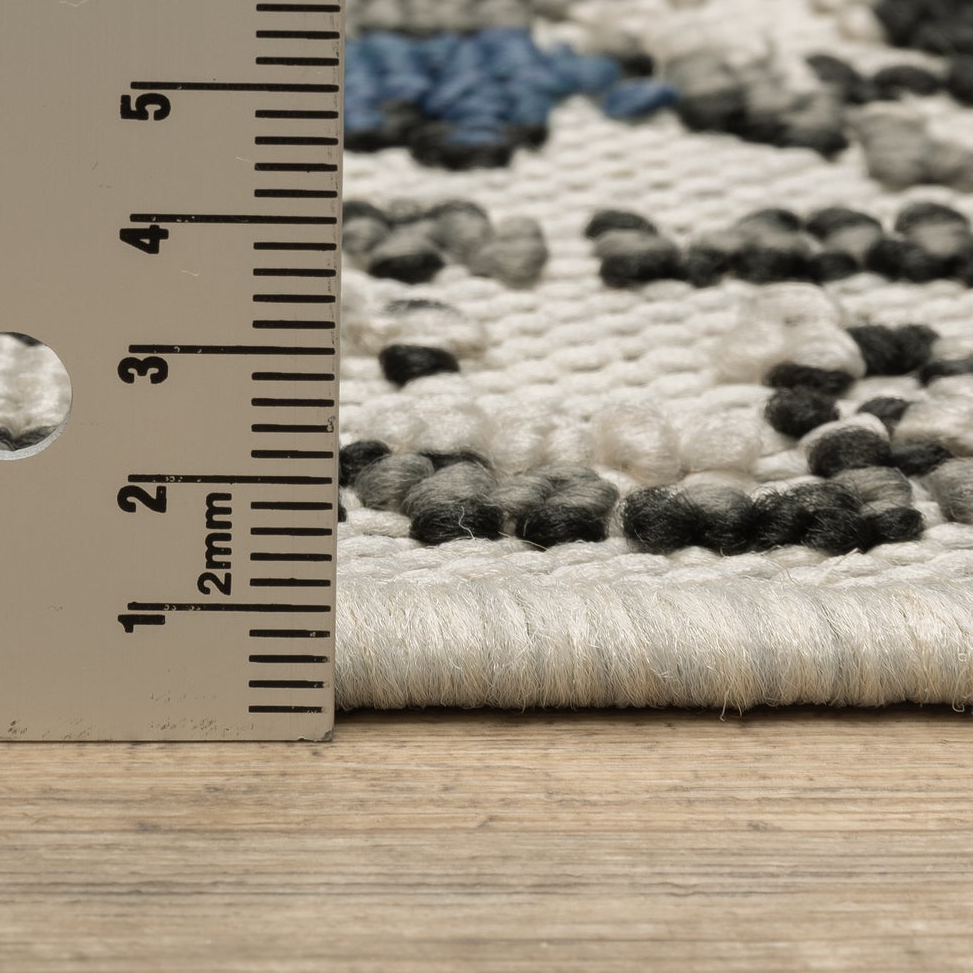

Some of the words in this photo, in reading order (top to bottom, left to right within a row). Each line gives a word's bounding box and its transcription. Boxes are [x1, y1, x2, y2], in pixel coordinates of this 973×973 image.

[119, 92, 172, 122] 5
[119, 224, 170, 255] 4
[116, 355, 169, 385] 3
[116, 484, 168, 514] 2
[196, 492, 233, 596] 2mm
[117, 613, 166, 634] 1
